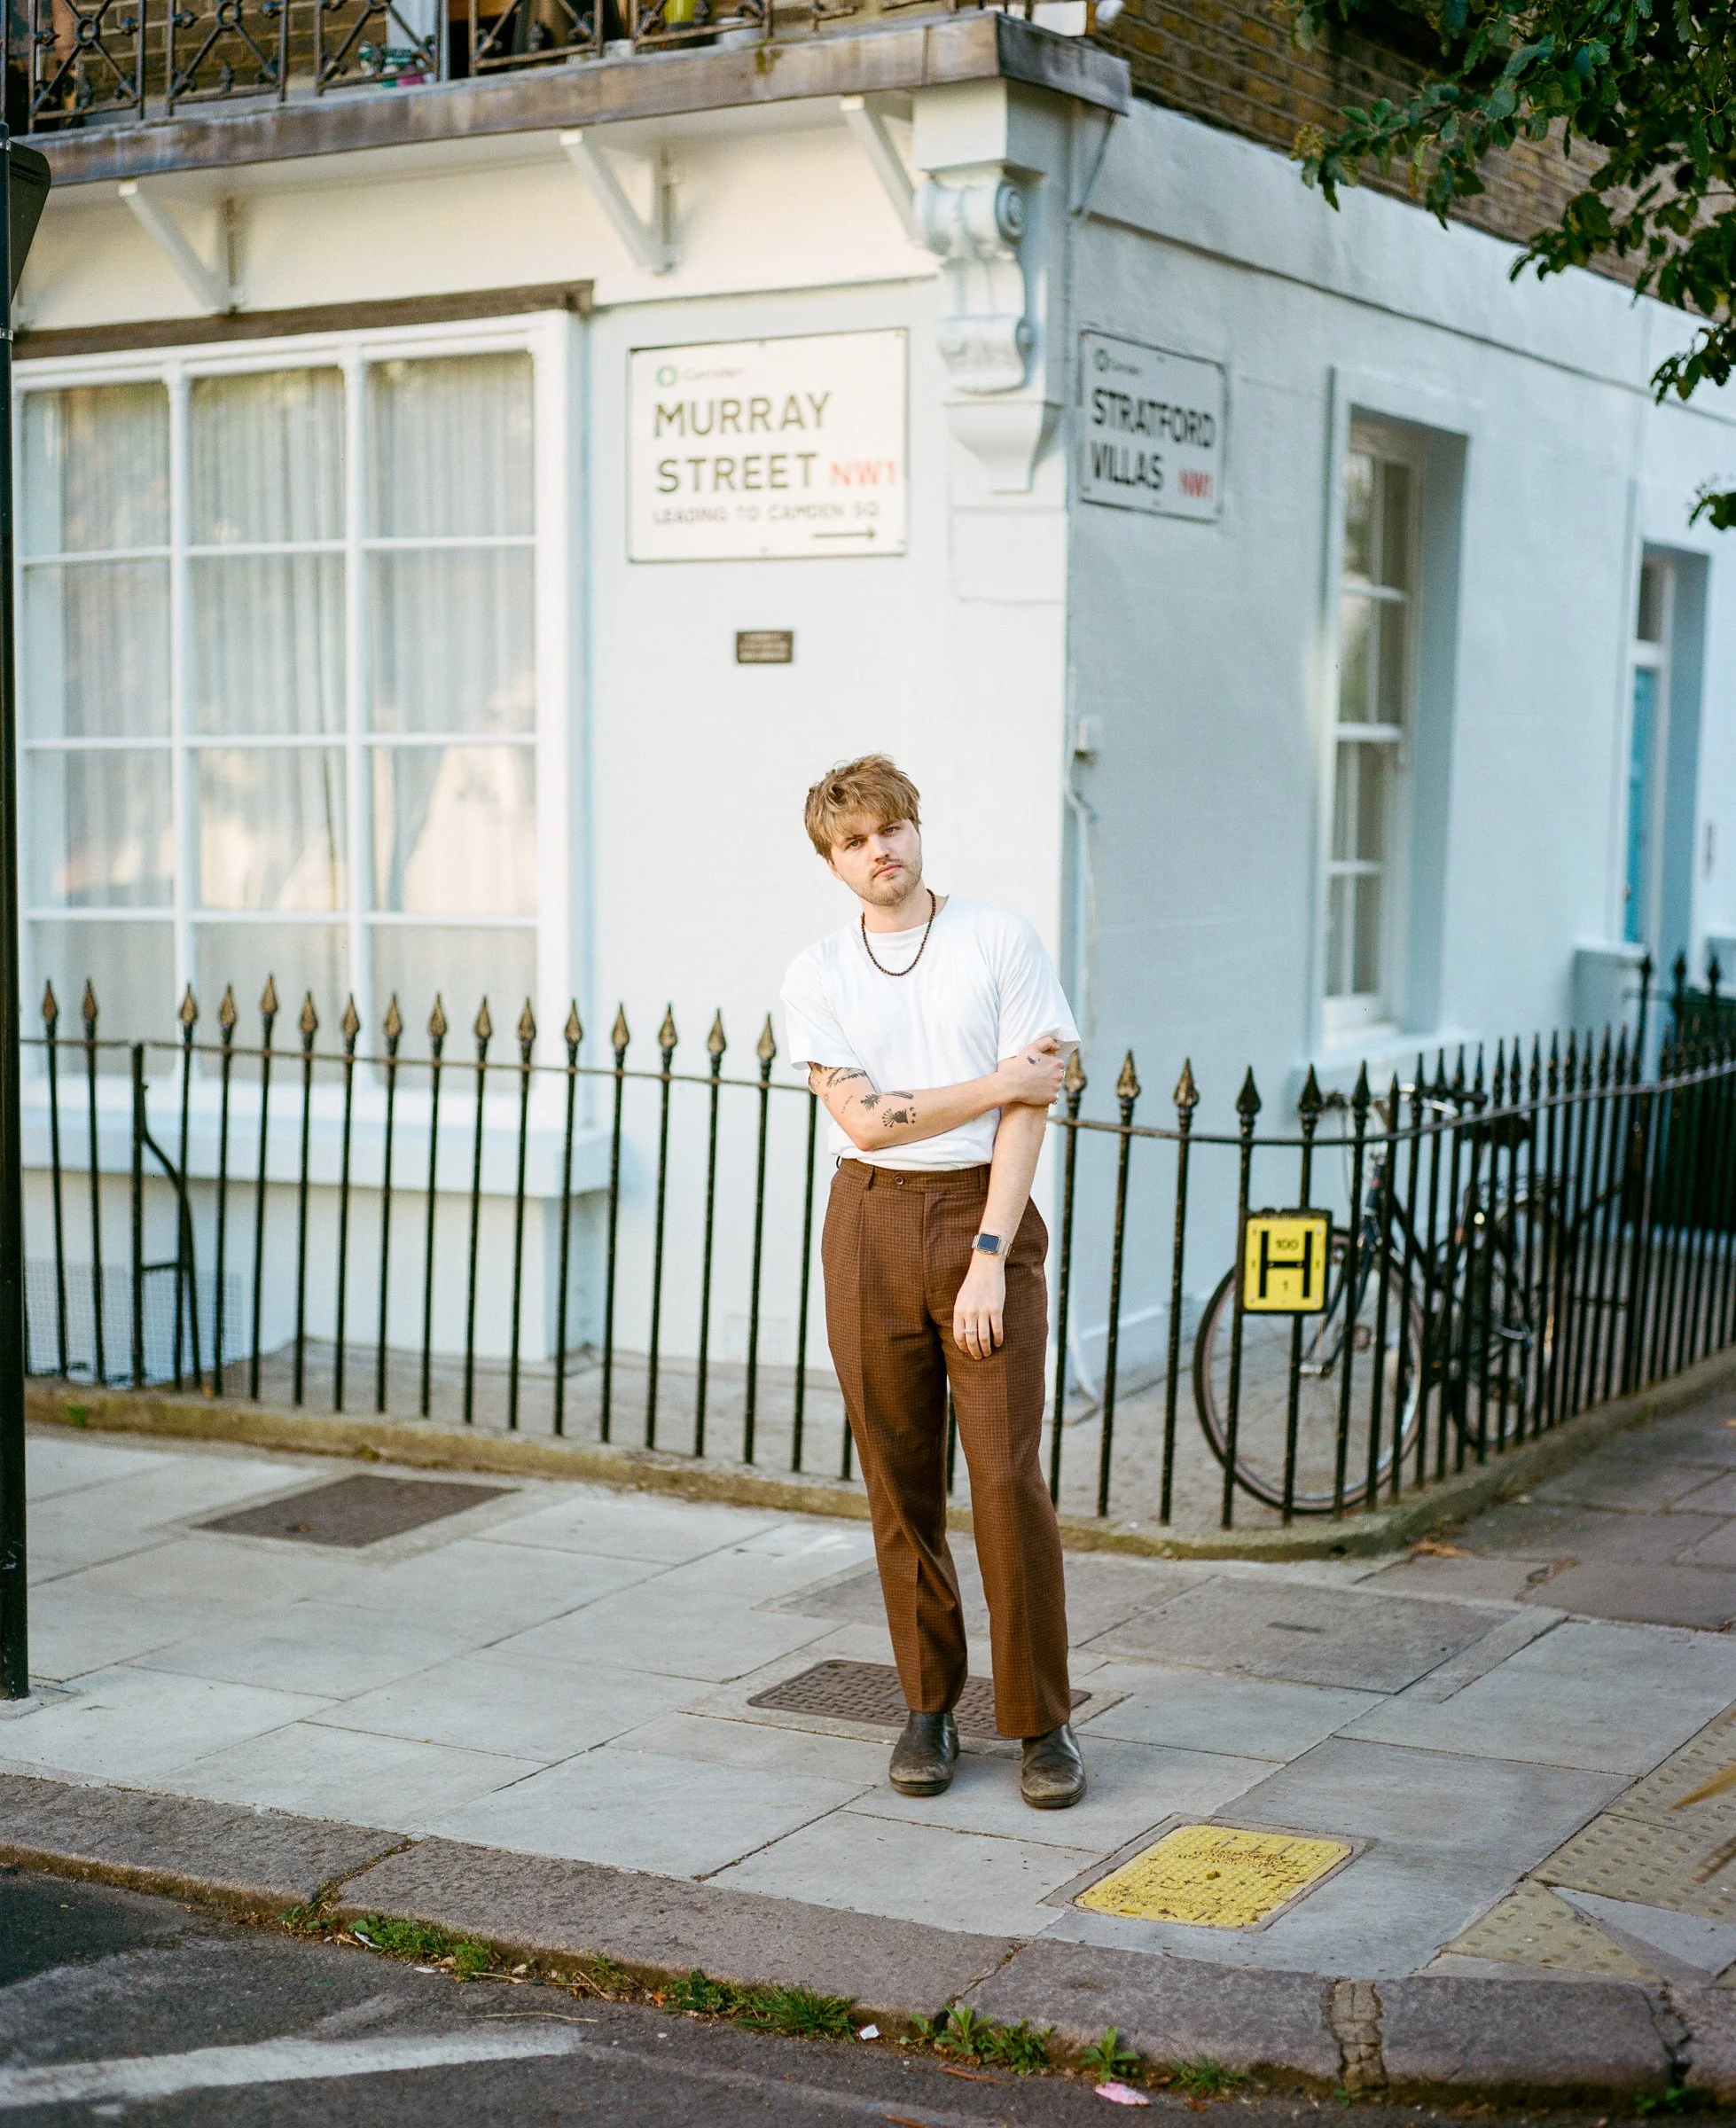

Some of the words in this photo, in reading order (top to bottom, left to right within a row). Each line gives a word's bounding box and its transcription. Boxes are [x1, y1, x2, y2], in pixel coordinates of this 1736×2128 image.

[653, 390, 832, 440] MURRAY
[1092, 387, 1216, 449] STRATFORD
[657, 451, 819, 494] STREET
[830, 459, 896, 488] NW1
[1091, 442, 1164, 491] VILLAS
[653, 506, 728, 527] LEADING
[736, 505, 760, 523] TO
[765, 501, 847, 522] CAMDEN
[1260, 1231, 1312, 1298] H
[1276, 1240, 1299, 1250] 100
